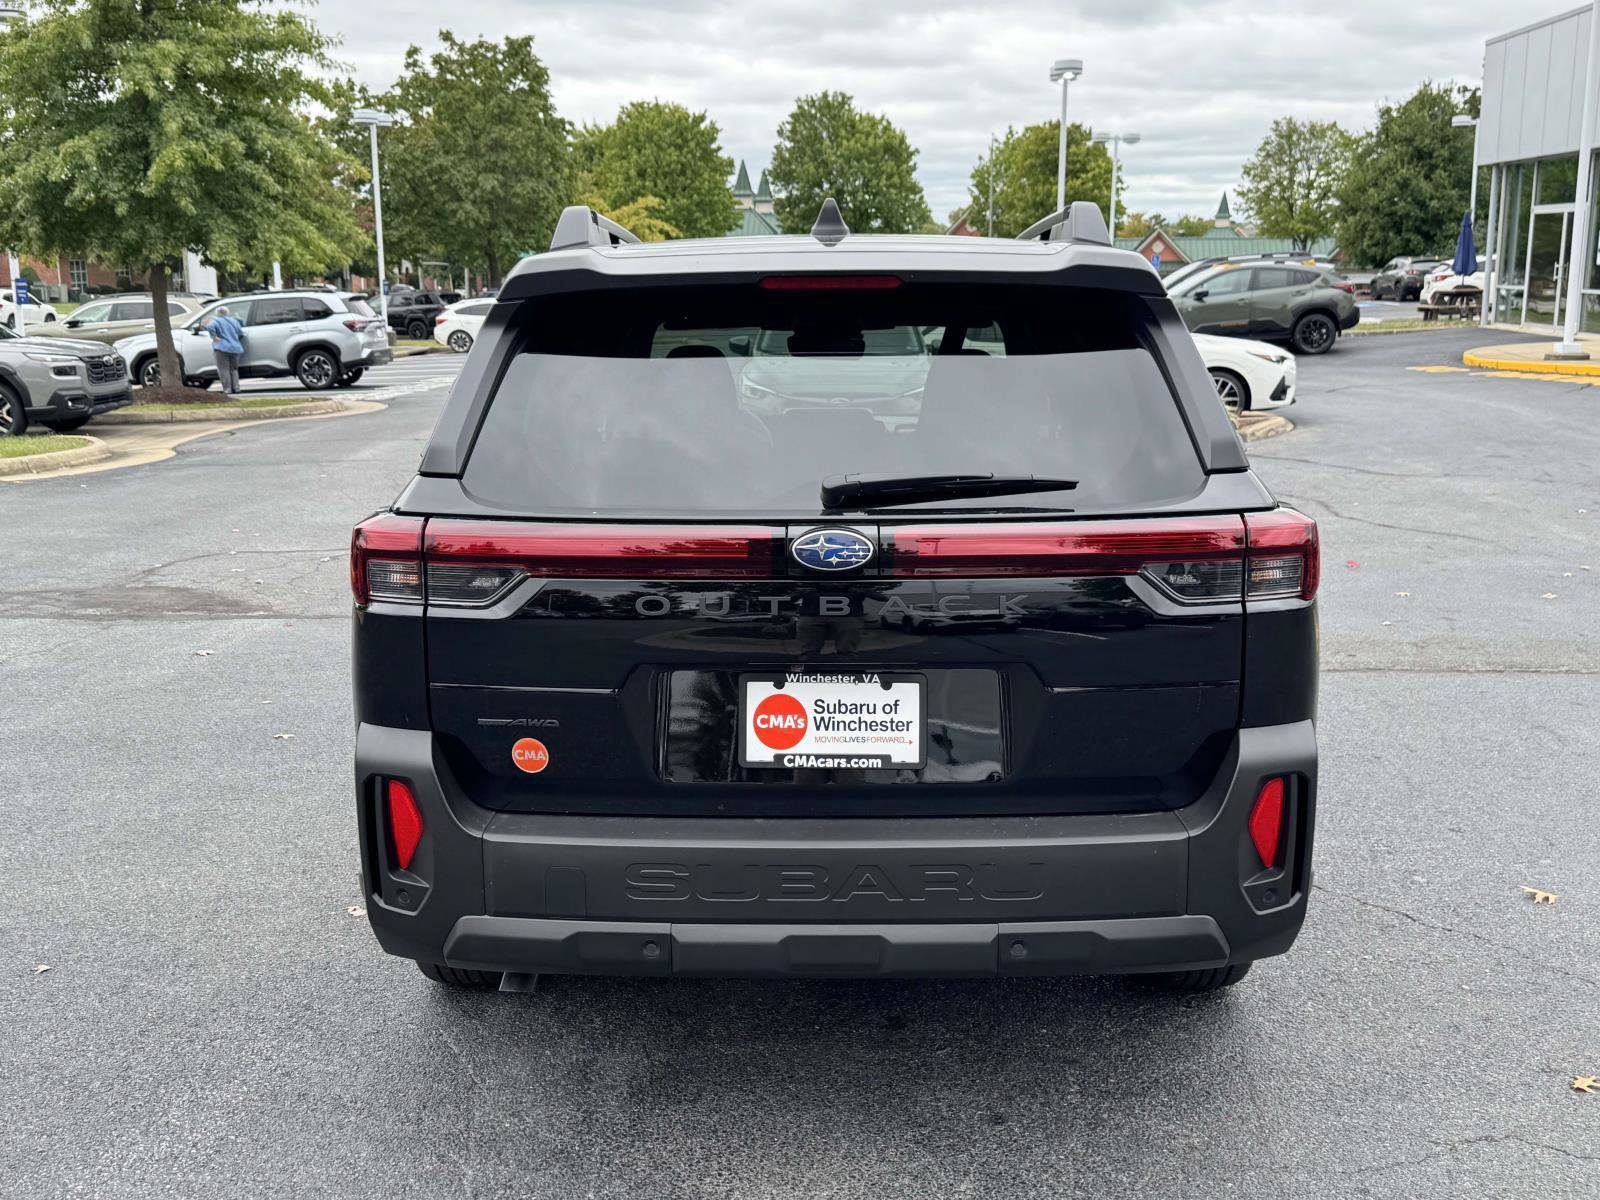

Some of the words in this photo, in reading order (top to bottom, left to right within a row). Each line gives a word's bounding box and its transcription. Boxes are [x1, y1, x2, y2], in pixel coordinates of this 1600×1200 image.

[635, 595, 1029, 617] OUTBACK
[785, 673, 859, 685] Winchester,
[862, 674, 881, 684] VA
[813, 698, 877, 715] Subaru
[881, 699, 901, 715] of
[505, 718, 560, 727] AWD
[756, 714, 806, 729] CMA's
[813, 716, 913, 732] Winchester
[514, 749, 546, 761] CMA
[783, 755, 882, 768] CMAcars.com
[625, 862, 1046, 902] SUBARU
